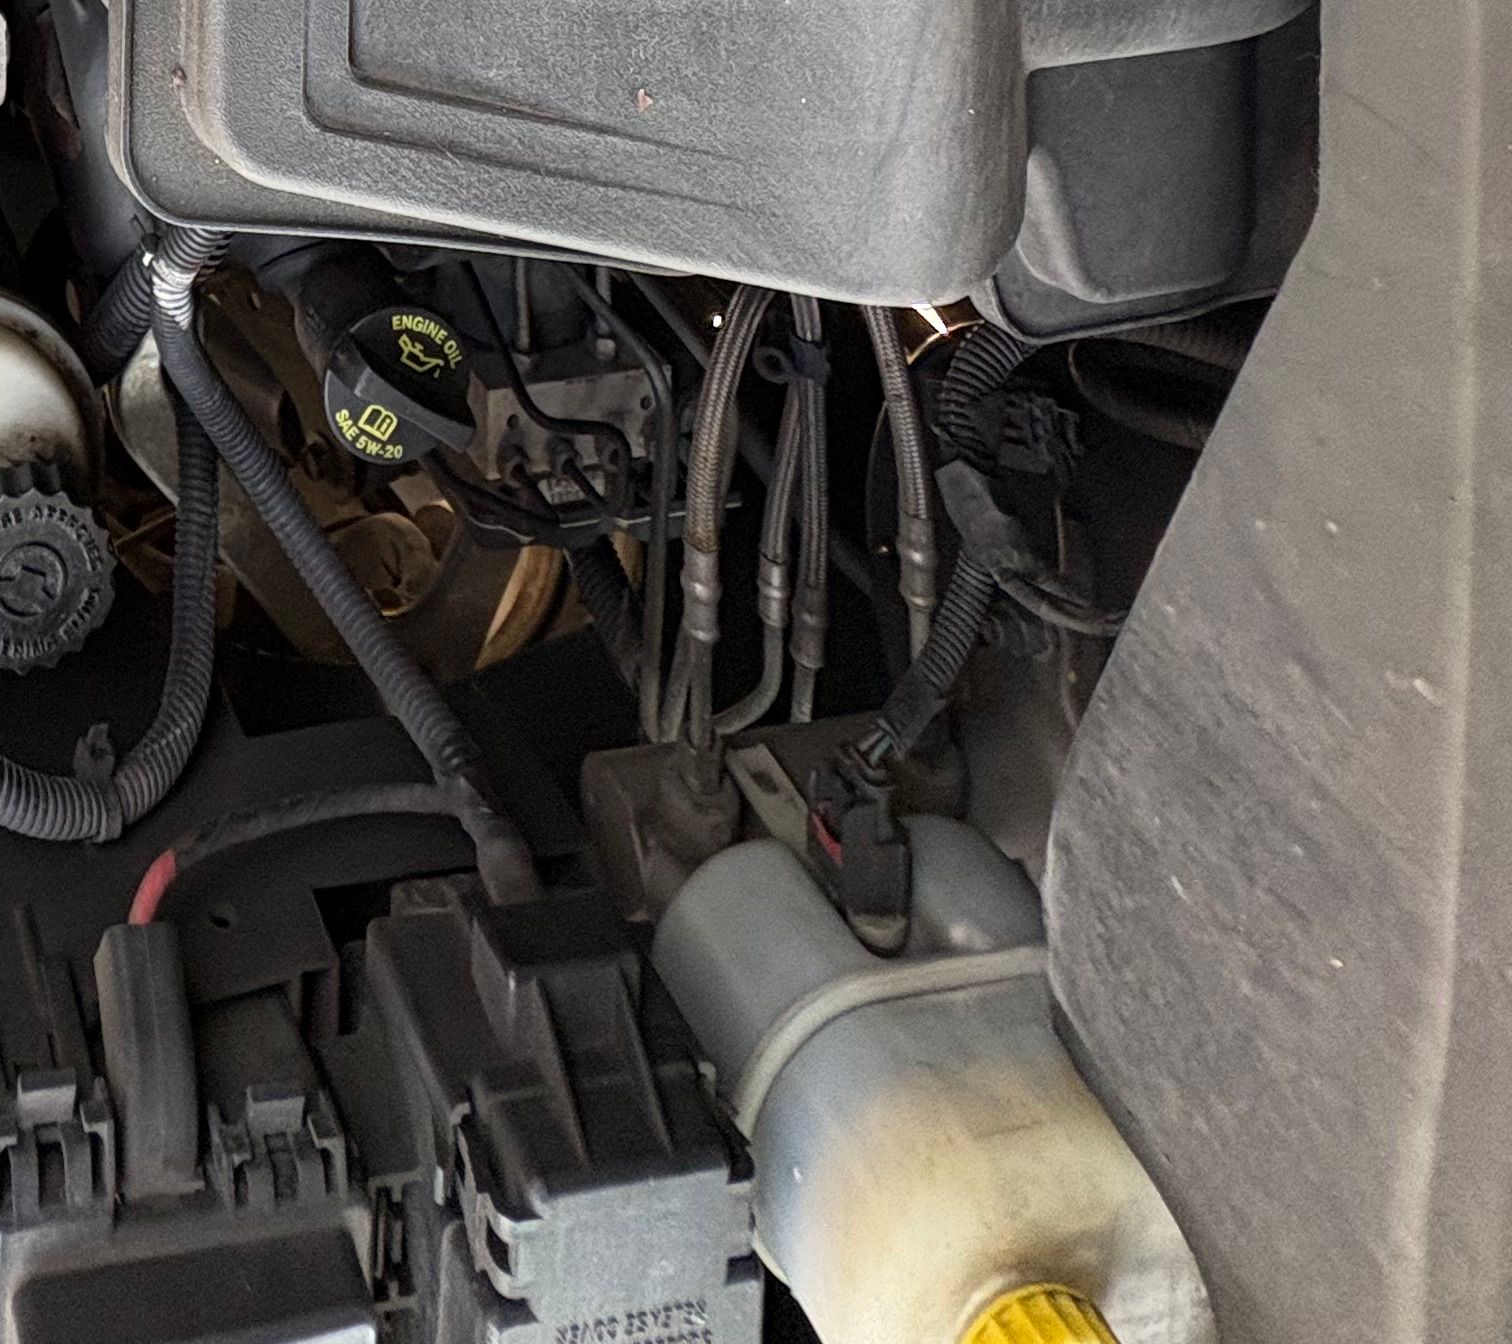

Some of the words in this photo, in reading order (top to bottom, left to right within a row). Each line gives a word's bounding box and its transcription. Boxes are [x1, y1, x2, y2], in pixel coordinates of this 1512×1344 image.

[391, 314, 448, 345] ENGINE
[444, 339, 463, 370] OIL
[334, 408, 361, 442] SAE
[355, 435, 404, 460] 5W-20
